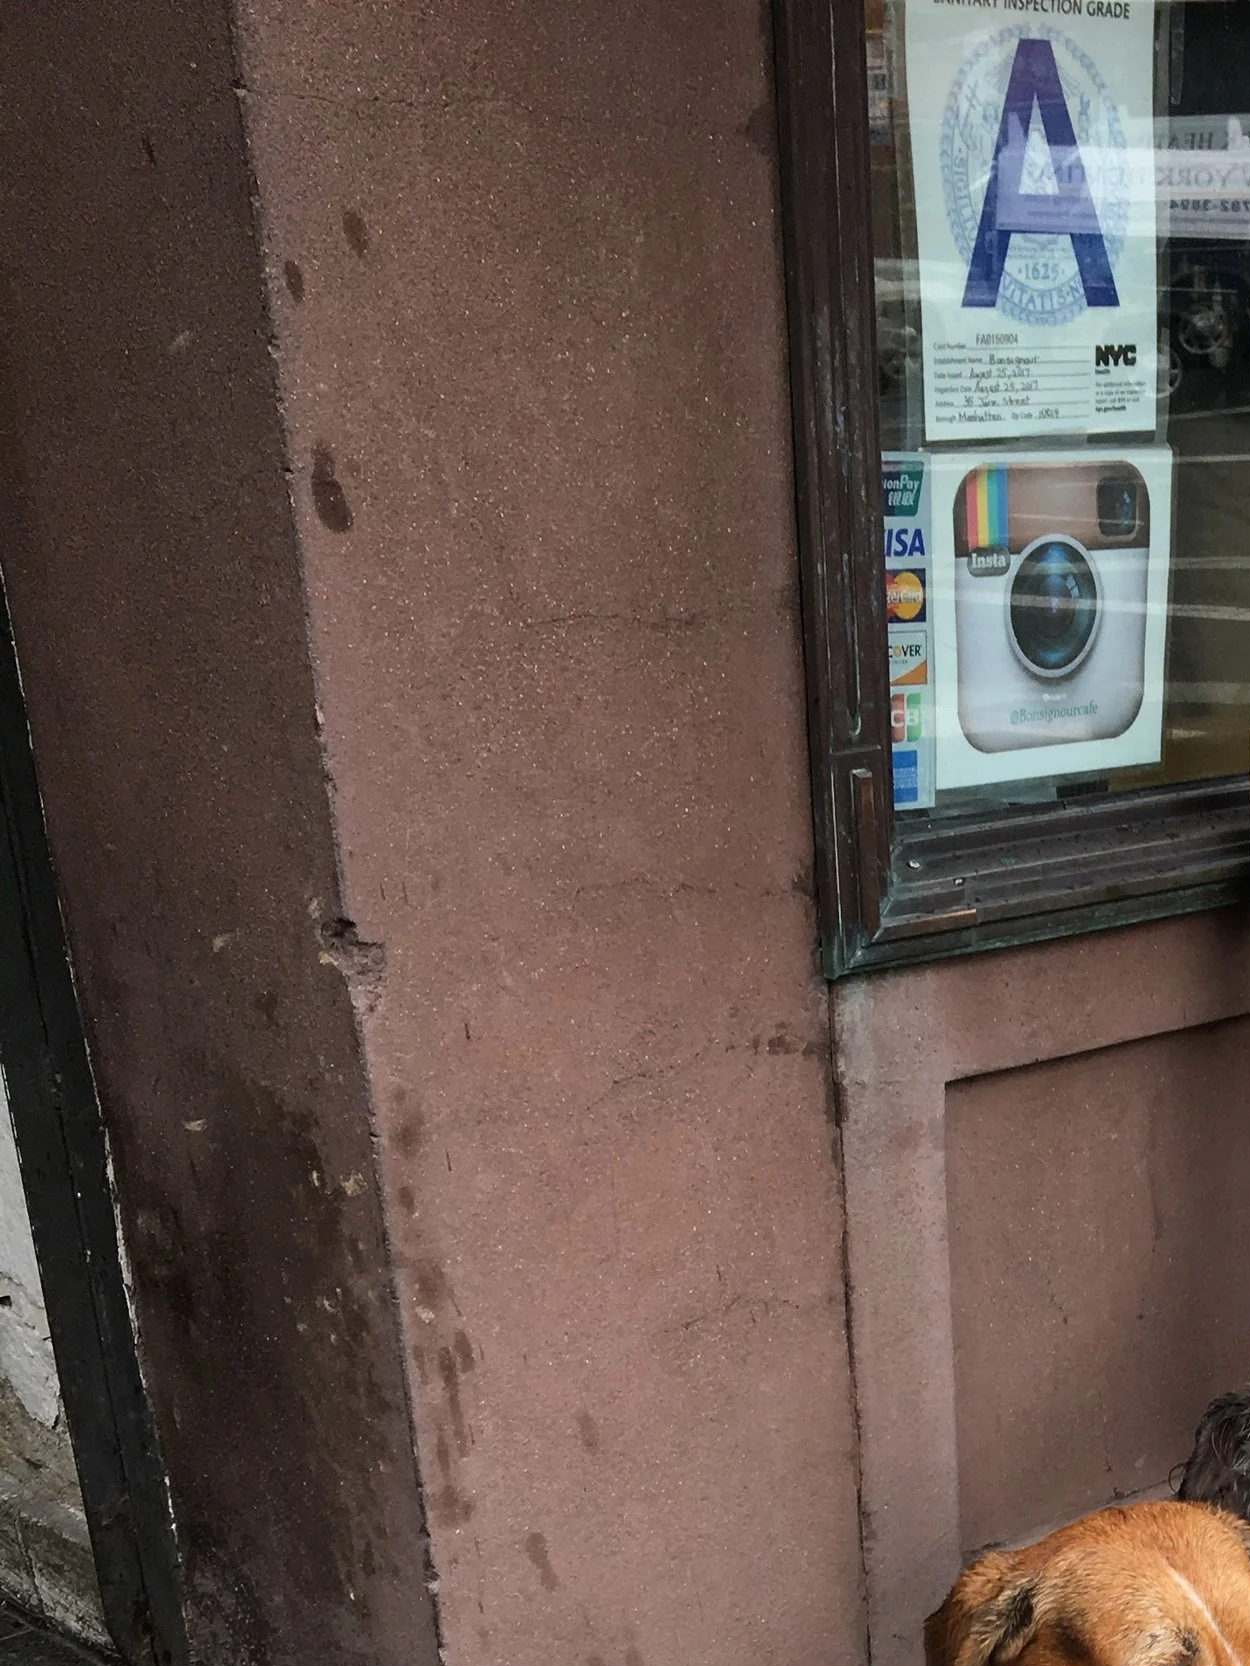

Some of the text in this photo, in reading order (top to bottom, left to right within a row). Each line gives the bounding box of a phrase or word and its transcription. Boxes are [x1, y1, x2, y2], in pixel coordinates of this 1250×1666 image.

[1003, 0, 1082, 15] INSPECTION
[1086, 0, 1130, 19] GRADE
[962, 39, 1120, 307] A
[1095, 344, 1137, 366] NYC
[883, 474, 920, 491] ionPay
[886, 528, 926, 557] ISA
[971, 553, 1007, 569] Insta
[888, 644, 922, 658] COVER
[891, 708, 920, 729] CB
